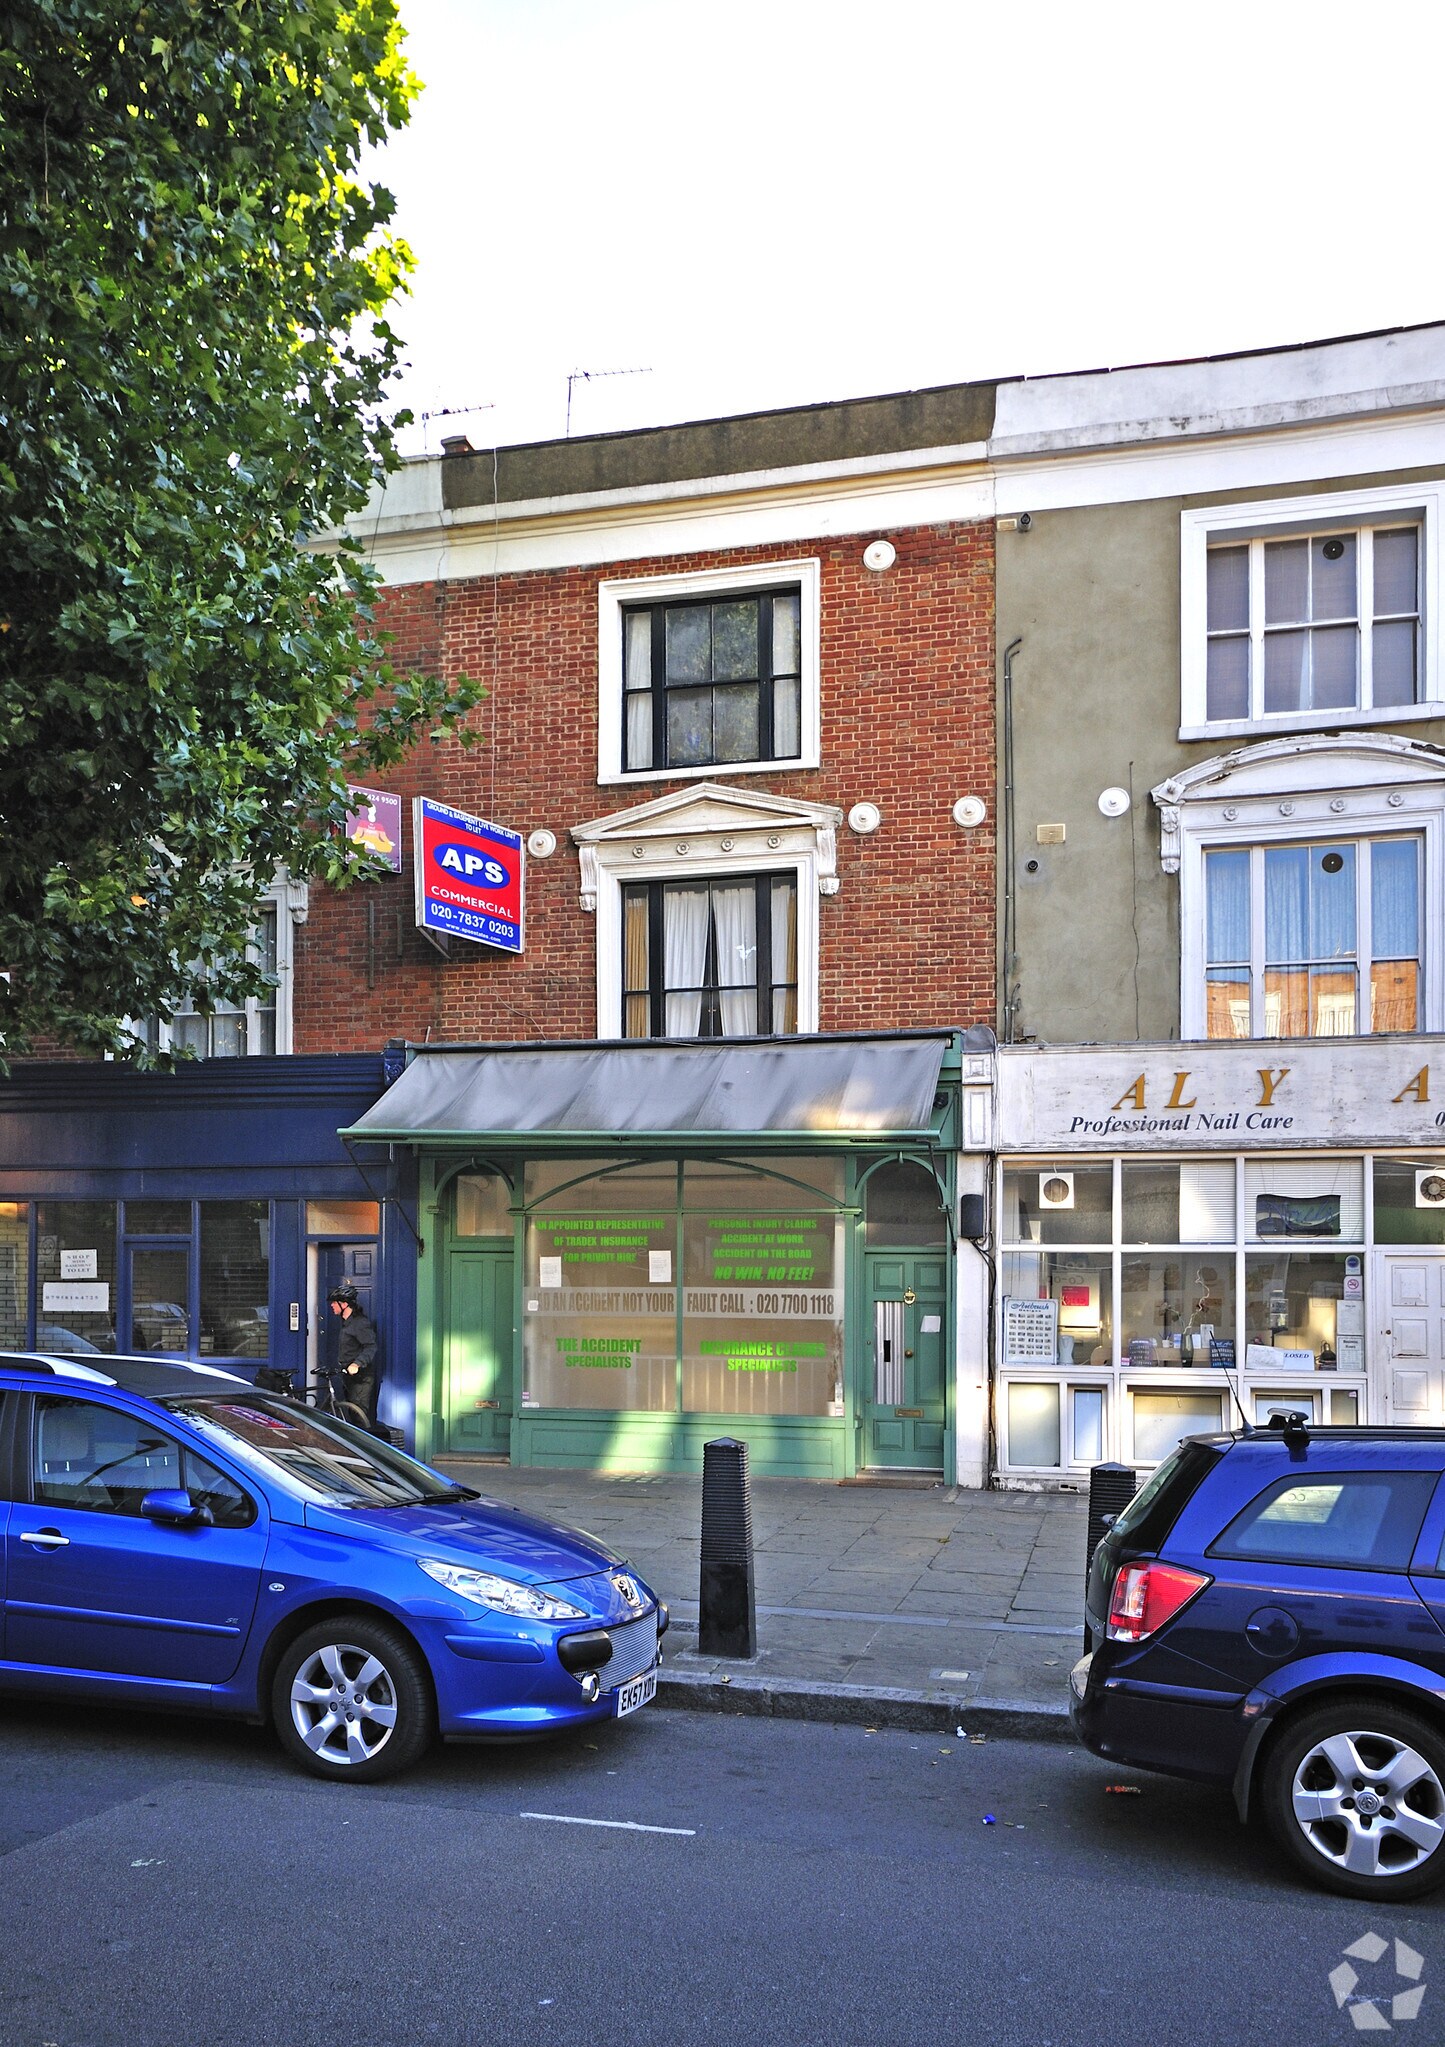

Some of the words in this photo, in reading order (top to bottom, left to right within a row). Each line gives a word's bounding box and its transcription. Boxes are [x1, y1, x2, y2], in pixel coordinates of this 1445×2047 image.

[381, 797, 398, 806] 9500
[426, 802, 449, 815] GROUND
[449, 810, 454, 818] &
[454, 812, 478, 826] BASEMENT
[478, 820, 490, 831] LIVE
[490, 824, 505, 836] WORK
[504, 830, 516, 840] UNIT
[465, 823, 473, 831] TO
[472, 827, 482, 835] LET
[440, 847, 504, 884] APS
[431, 886, 514, 918] COMMERCIAL
[488, 920, 514, 938] 0203
[1069, 1114, 1191, 1136] Professional
[1196, 1113, 1240, 1131] Nail
[1245, 1112, 1294, 1130] Care
[548, 1220, 594, 1230] APPOINTED
[596, 1219, 666, 1230] REPRESENTATIVE
[708, 1218, 751, 1229] PERSONAL
[753, 1219, 782, 1229] INJURY
[784, 1219, 817, 1229] CLAIMS
[554, 1236, 564, 1246] OF
[566, 1236, 597, 1246] TRADEX
[600, 1236, 648, 1246] INSURANCE
[721, 1234, 762, 1244] ACCIDENT
[764, 1234, 775, 1244] AT
[777, 1234, 804, 1244] WORK
[564, 1252, 580, 1263] FOR
[581, 1252, 616, 1263] PRIVATE
[713, 1248, 755, 1259] ACCIDENT
[757, 1249, 770, 1258] ON
[771, 1249, 786, 1258] THE
[788, 1249, 812, 1259] ROAD
[713, 1266, 732, 1280] NO
[766, 1266, 786, 1281] NO
[787, 1266, 816, 1281] FEE!
[553, 1292, 566, 1312] AN
[569, 1292, 620, 1312] ACCIDENT
[622, 1292, 643, 1312] NOT
[645, 1292, 674, 1312] YOUR
[686, 1292, 718, 1313] FAULT
[720, 1293, 746, 1313] CALL
[756, 1294, 779, 1314] 020
[782, 1294, 808, 1315] 7700
[810, 1294, 835, 1315] 1118
[556, 1338, 578, 1352] THE
[580, 1338, 642, 1354] ACCIDENT
[700, 1340, 774, 1356] INSURANCE
[565, 1355, 632, 1369] SPECIALISTS
[727, 1358, 798, 1372] SPECIALISTS
